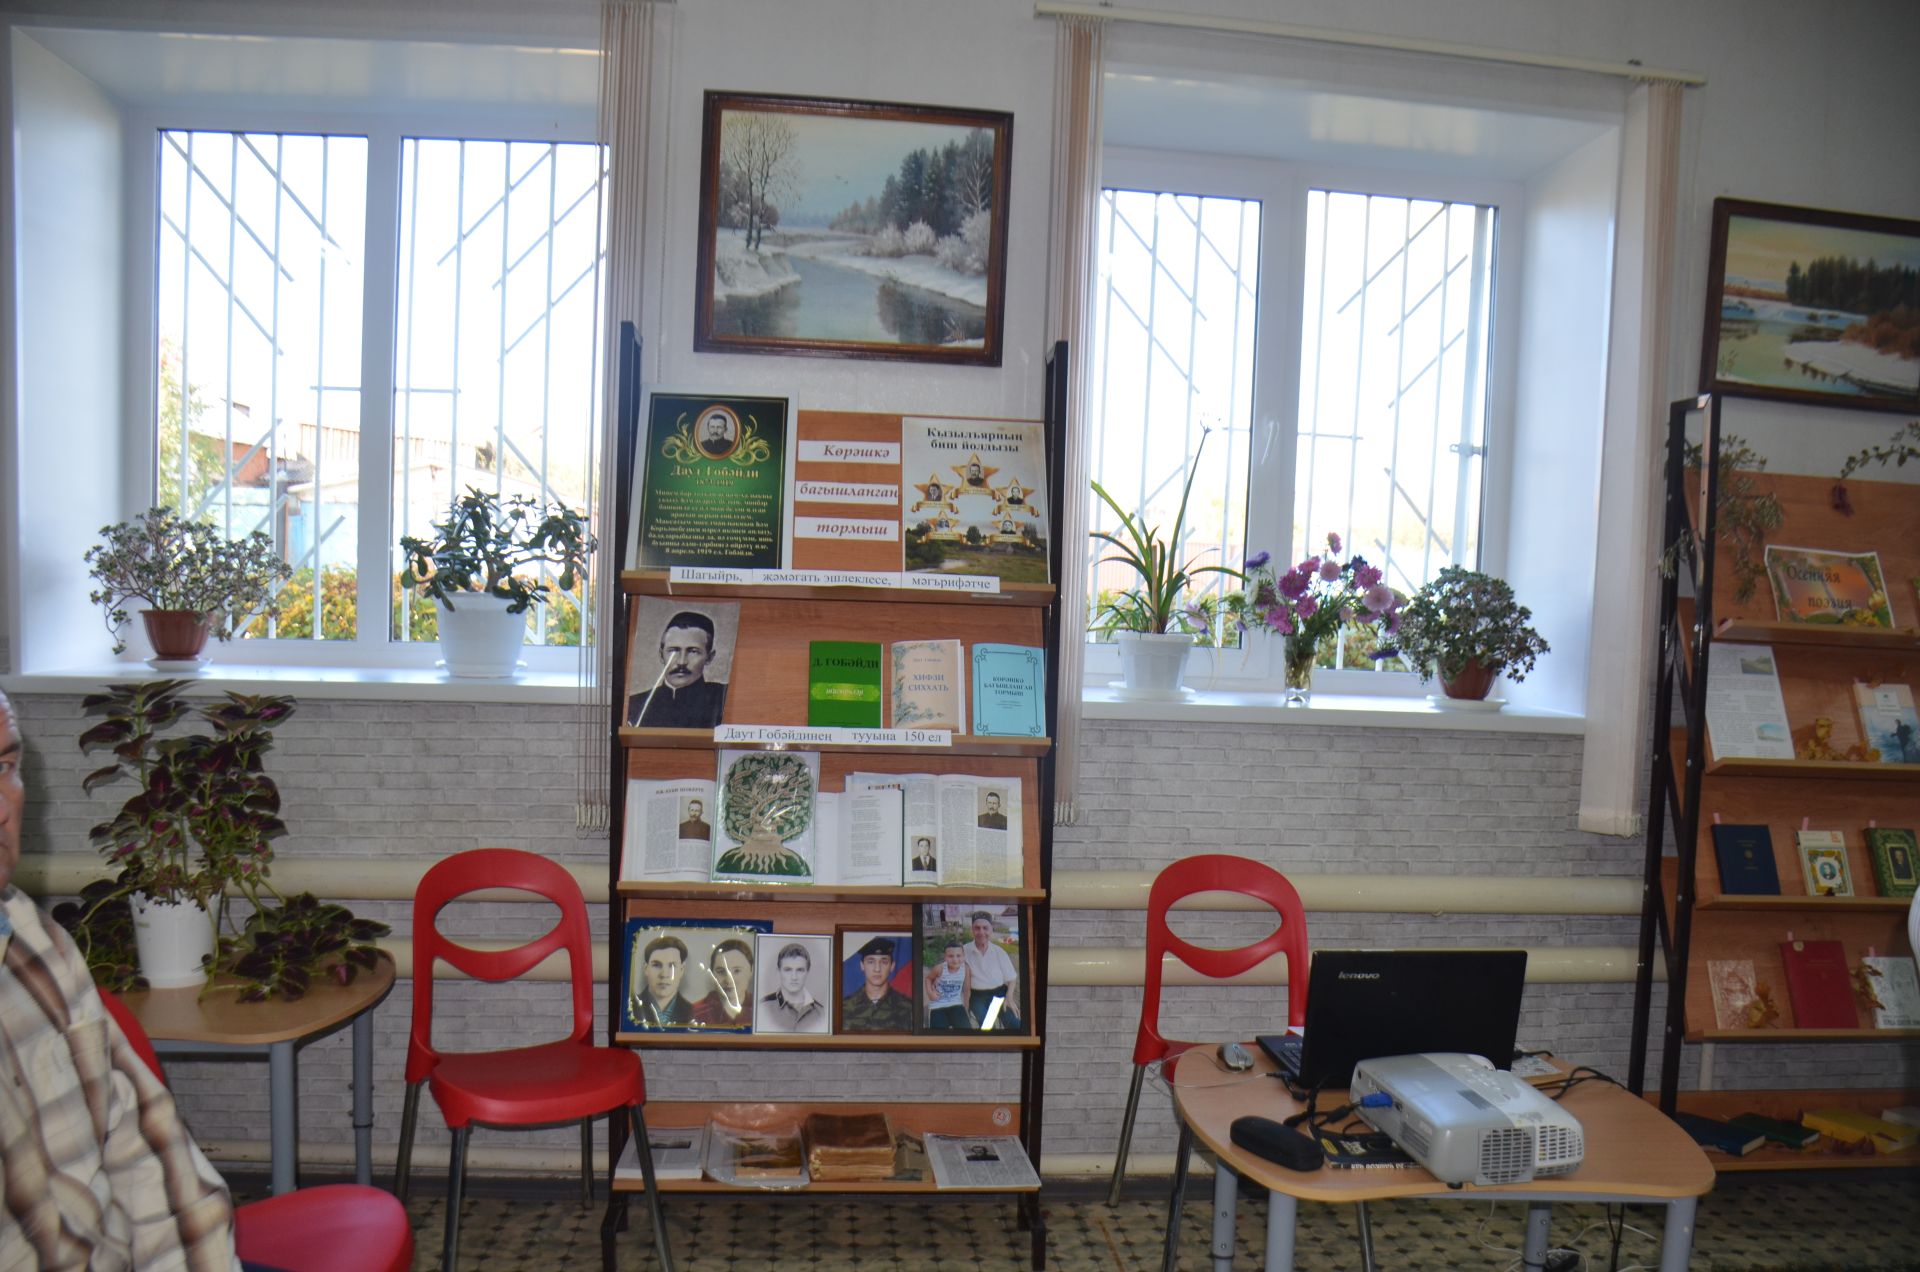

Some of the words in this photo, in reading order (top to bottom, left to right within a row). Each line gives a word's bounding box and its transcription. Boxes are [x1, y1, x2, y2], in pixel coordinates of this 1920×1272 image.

[823, 444, 890, 459] Көрәшкә
[930, 440, 959, 450] биш
[962, 440, 1019, 452] йолдызы
[800, 483, 899, 501] багышланган
[816, 523, 888, 536] тормыш
[680, 568, 743, 583] Шагыйрь,
[823, 574, 892, 588] эшлеклесе,
[911, 575, 991, 590] мәгърифәтче
[1808, 597, 1853, 611] поэзия
[724, 727, 755, 742] Даут
[851, 732, 896, 743] тууына
[904, 731, 925, 743] 150
[927, 735, 942, 743] ел
